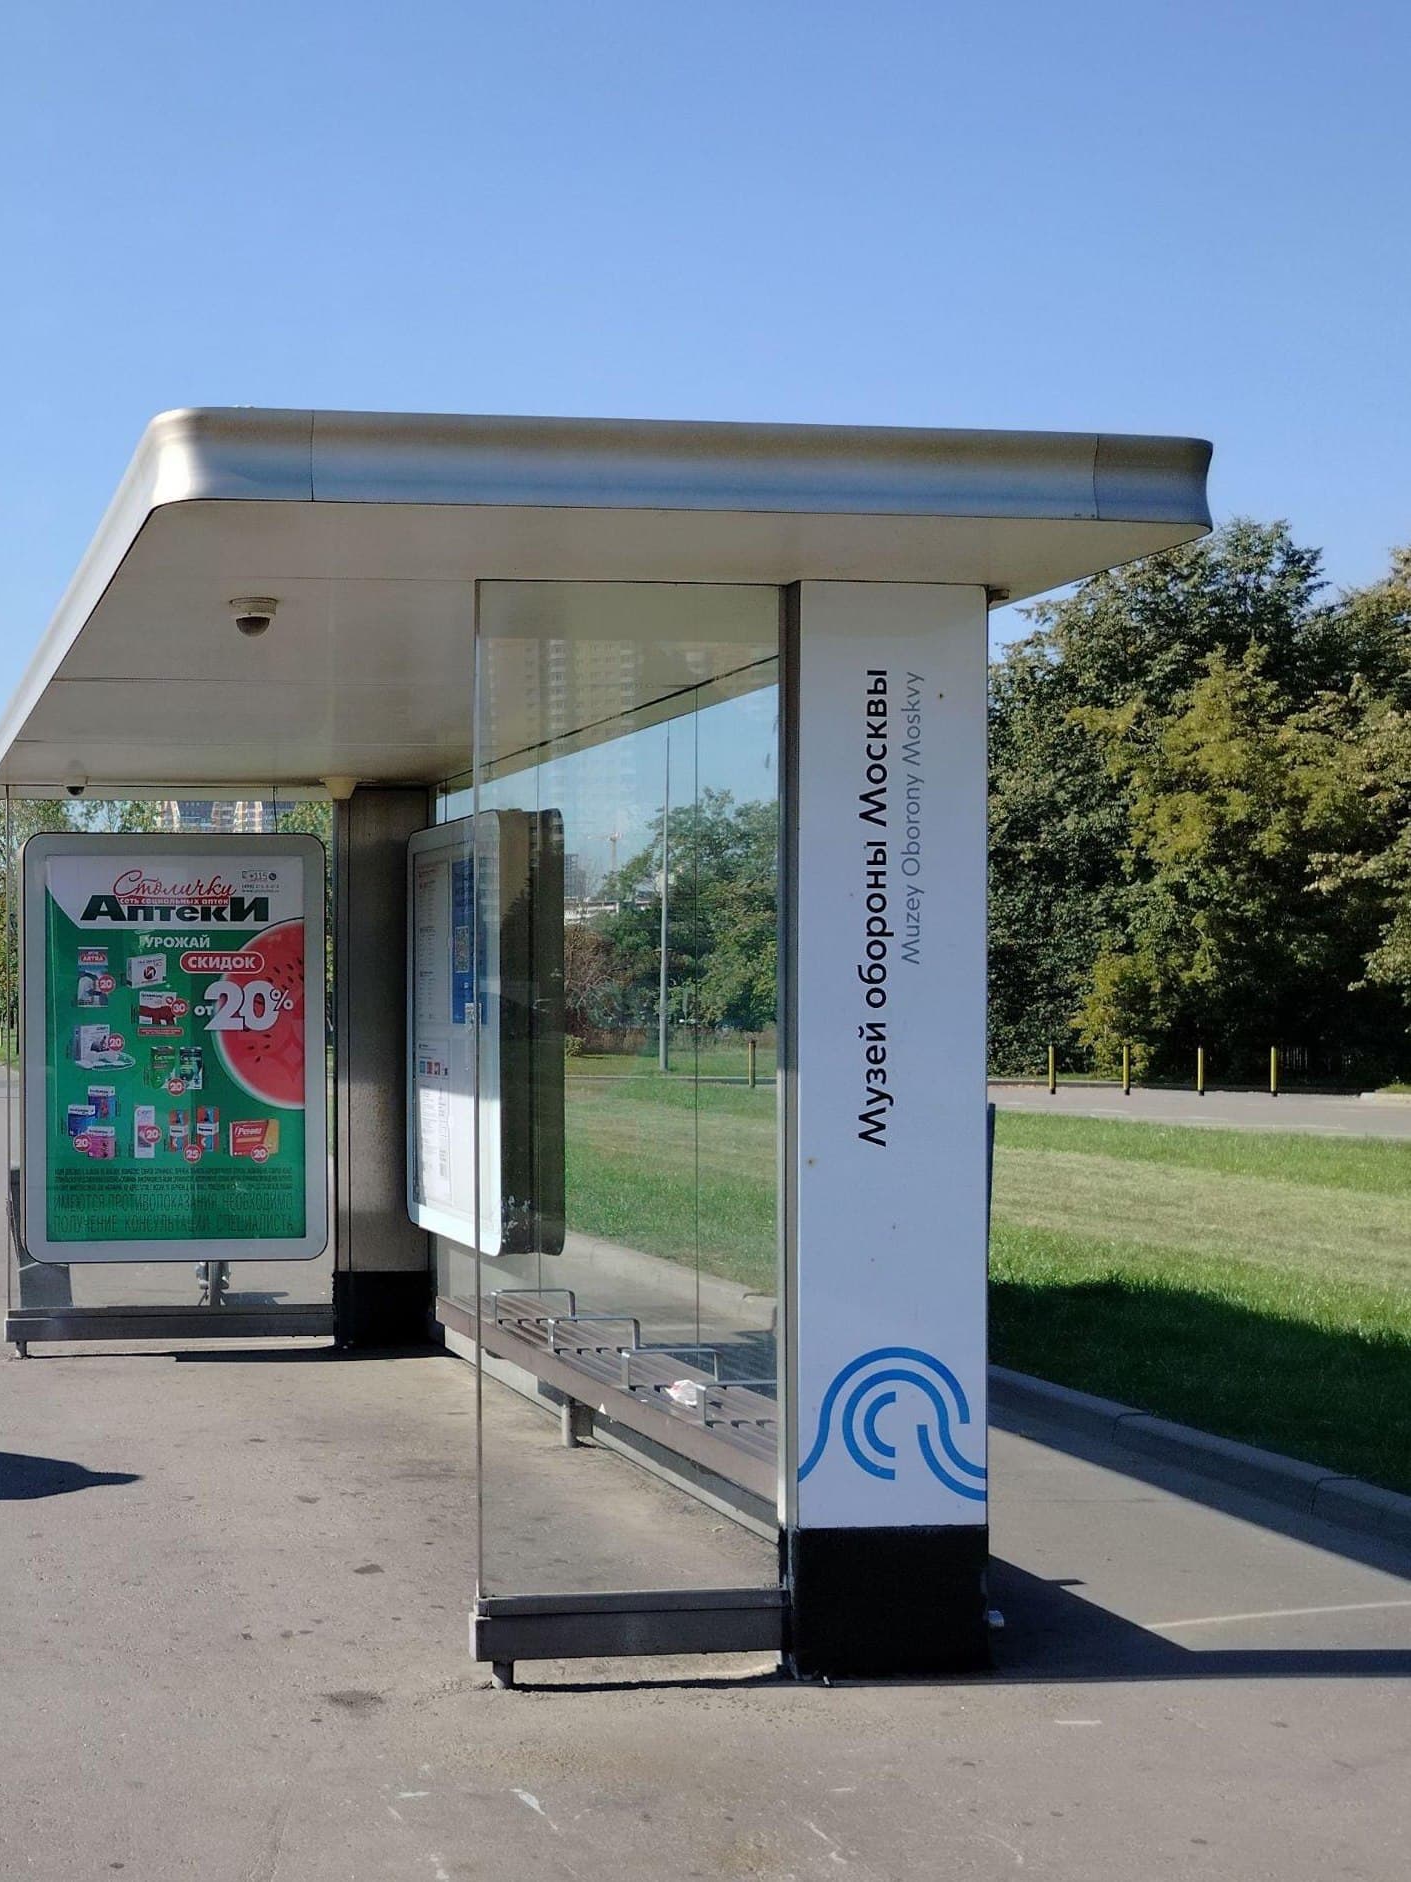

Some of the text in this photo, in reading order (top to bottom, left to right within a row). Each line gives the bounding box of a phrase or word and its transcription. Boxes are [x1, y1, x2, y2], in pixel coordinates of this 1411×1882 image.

[901, 671, 925, 965] Muzey Oborony Moskvy
[113, 869, 237, 899] Столички
[202, 898, 229, 906] аптек
[857, 669, 894, 1147] Музей обороны Москвы
[146, 934, 210, 948] УРОЖАЙ
[187, 956, 256, 971] СКИДОК
[99, 979, 113, 989] 20
[173, 1003, 187, 1013] 30
[194, 1004, 214, 1016] от
[109, 1038, 122, 1047] 20
[145, 1129, 159, 1139] 20
[75, 1138, 89, 1148] 20
[185, 1149, 199, 1159] 25
[253, 1148, 266, 1158] 20
